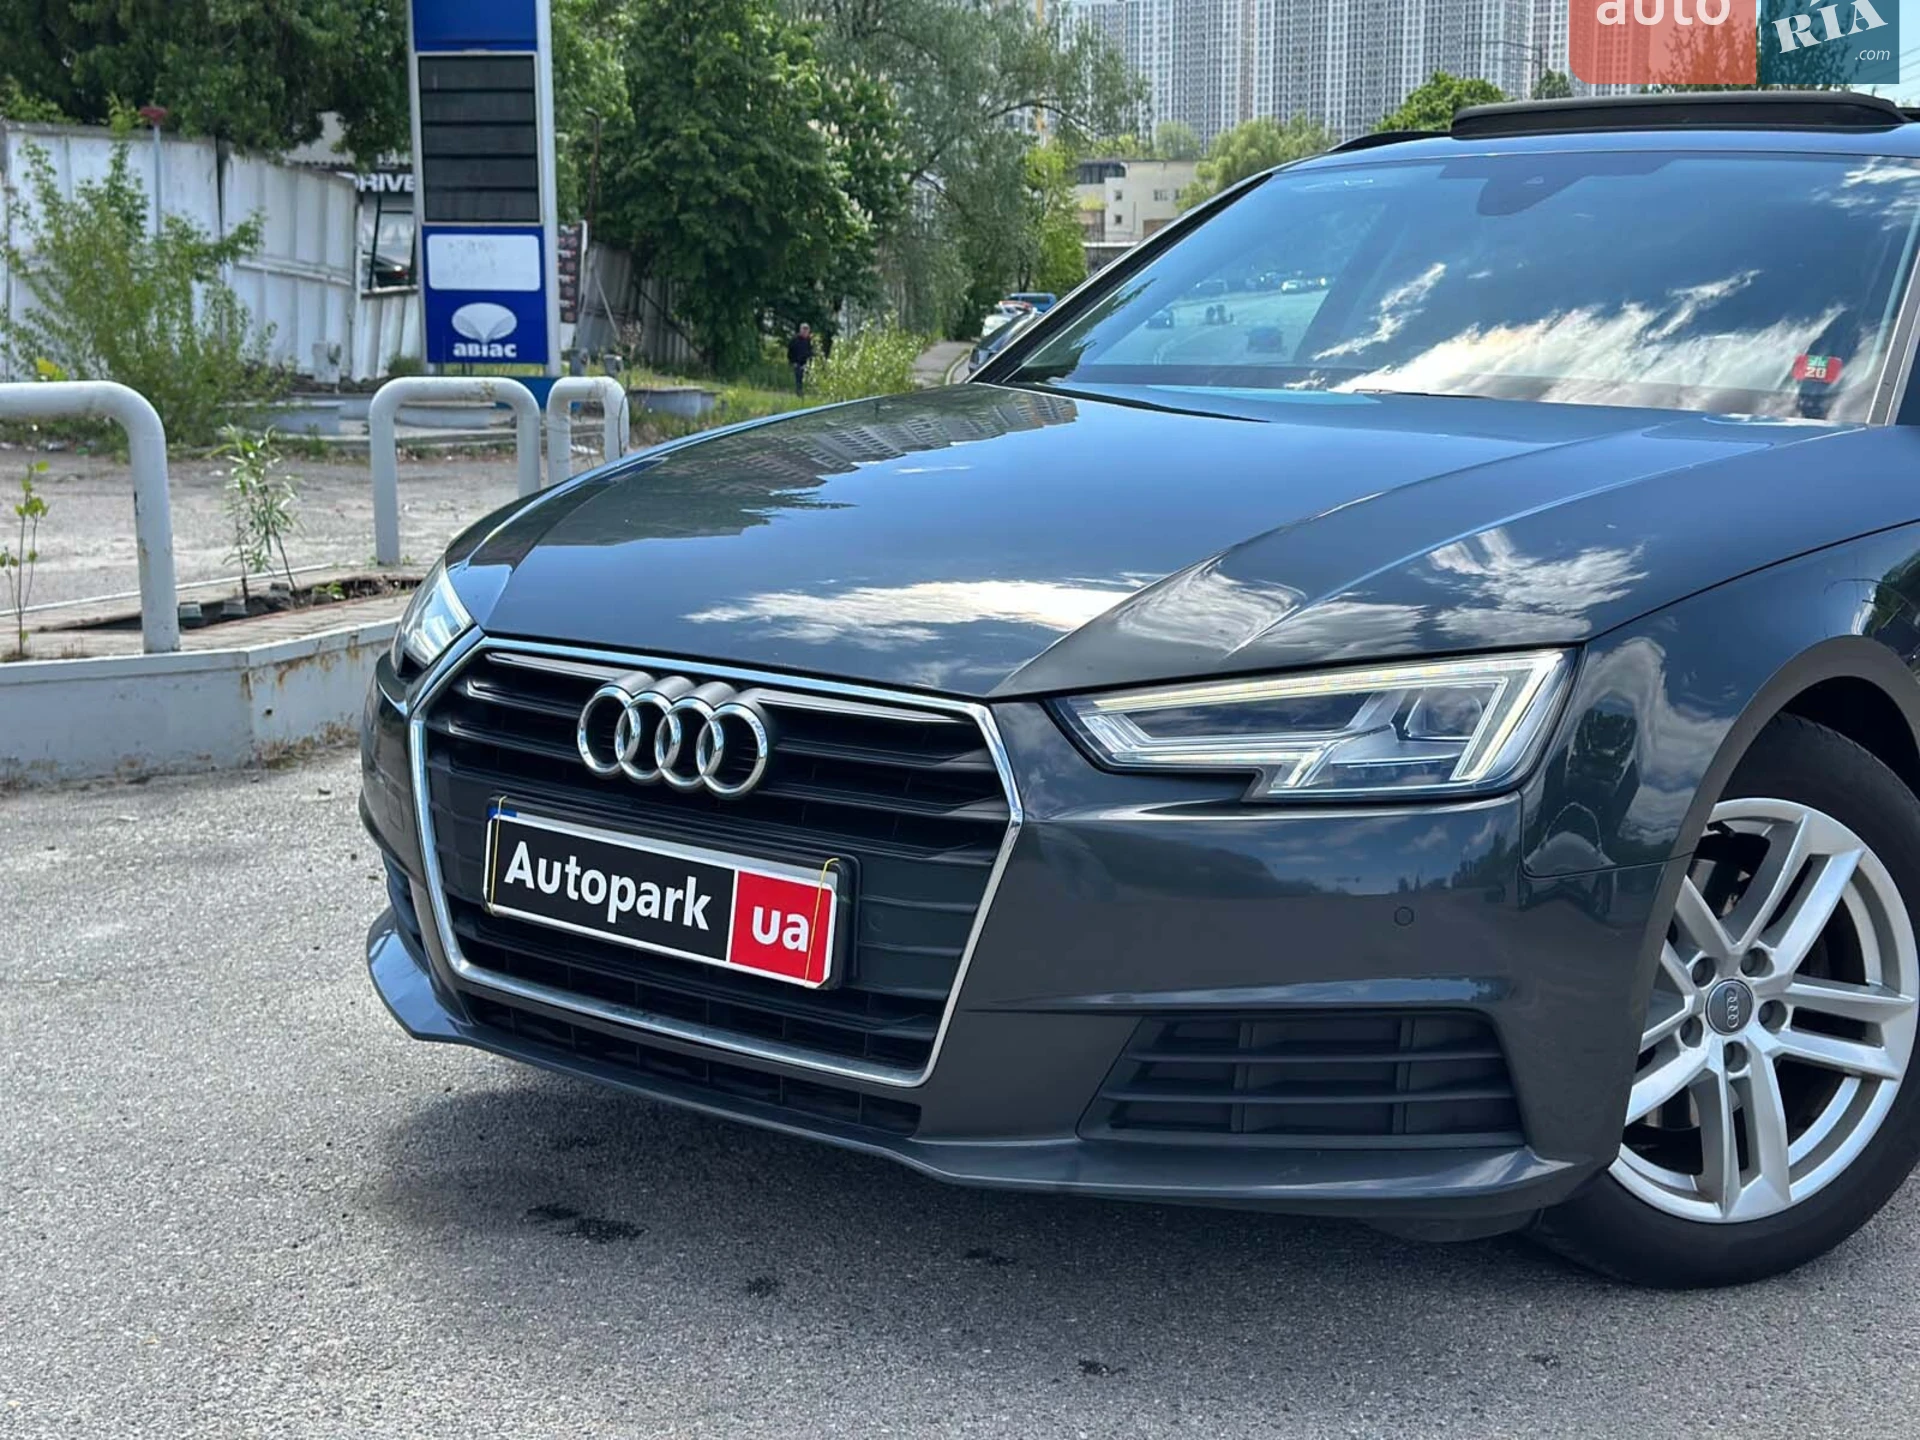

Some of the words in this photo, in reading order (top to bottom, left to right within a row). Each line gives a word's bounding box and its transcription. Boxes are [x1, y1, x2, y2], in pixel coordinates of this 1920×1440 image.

[355, 173, 415, 192] RIVE
[504, 841, 711, 930] Autopark
[751, 905, 809, 952] ua
